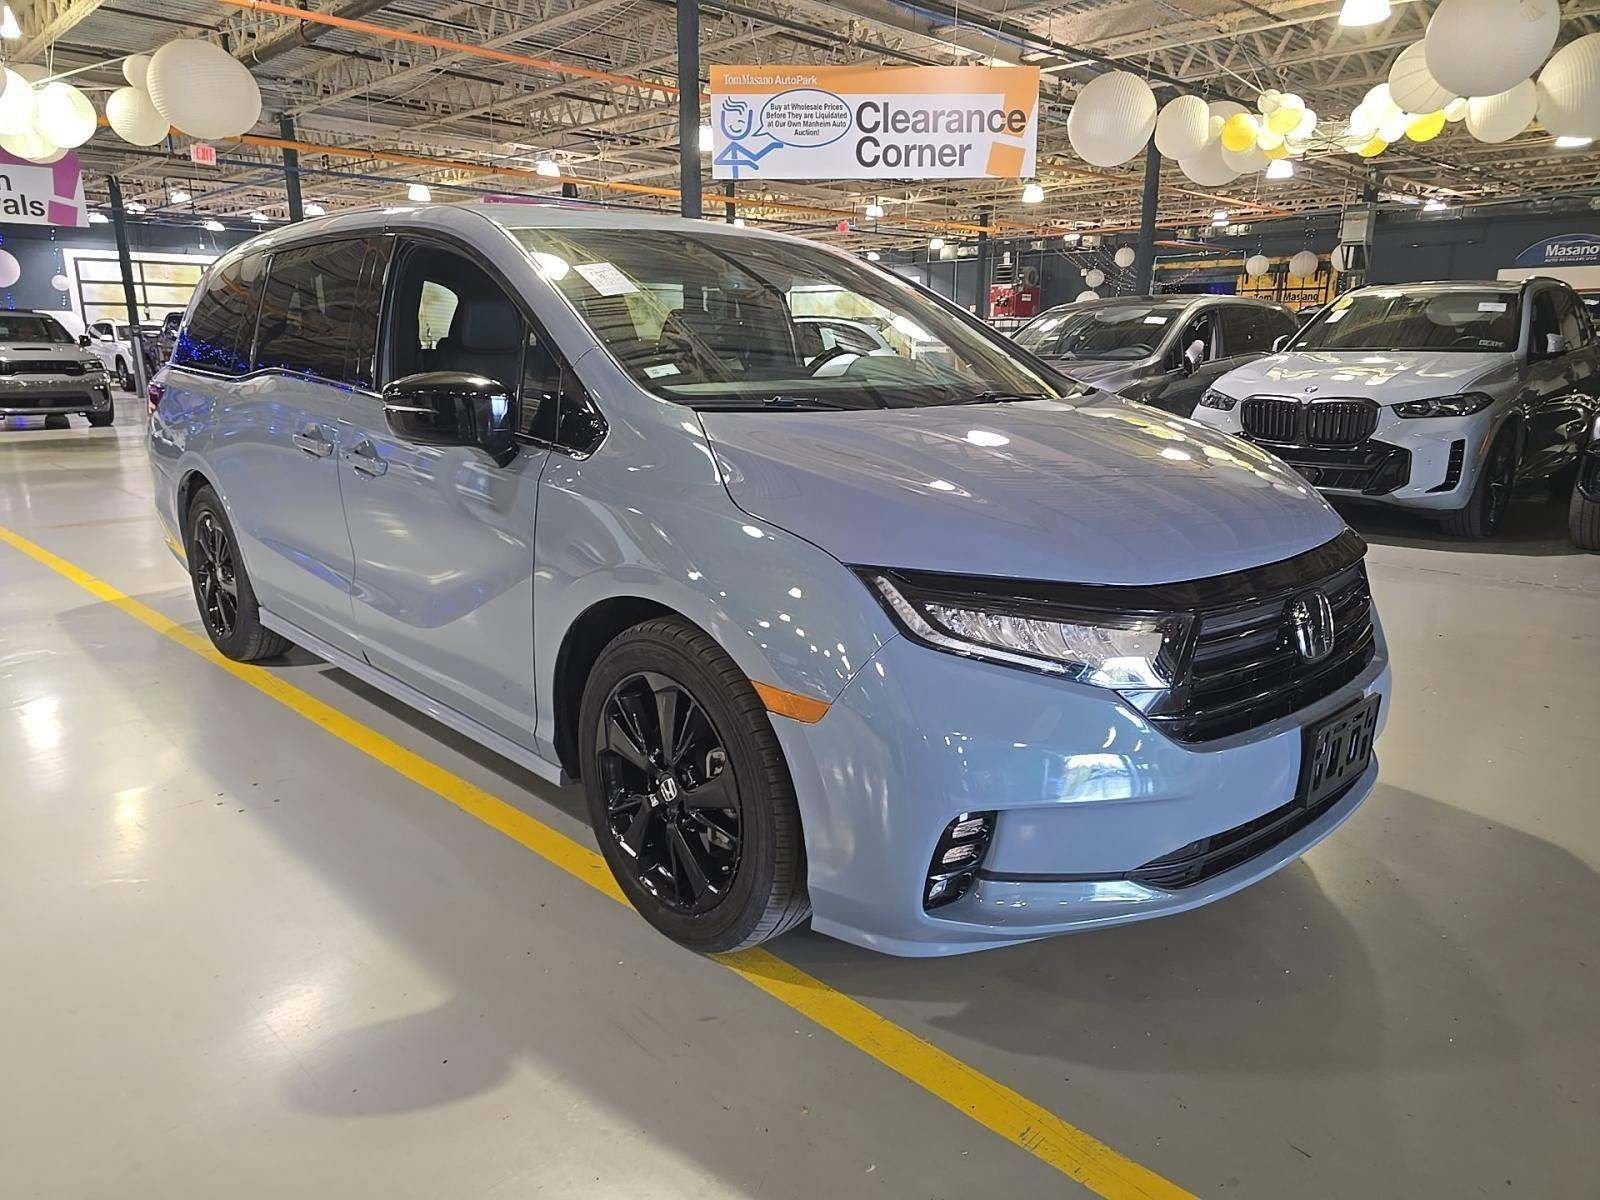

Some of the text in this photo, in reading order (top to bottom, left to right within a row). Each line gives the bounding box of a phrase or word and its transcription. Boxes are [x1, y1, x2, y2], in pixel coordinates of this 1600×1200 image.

[723, 74, 817, 85] Tom Masano AutoPark
[770, 103, 782, 111] Buy
[791, 103, 823, 111] Wholesale
[824, 103, 843, 111] Prices
[788, 112, 802, 120] They
[815, 112, 848, 120] Liquidated
[856, 101, 1027, 134] Clearance
[196, 147, 212, 161] EXIT
[856, 136, 972, 168] Corner
[0, 194, 46, 217] als
[1545, 244, 1600, 257] Masano
[1284, 292, 1319, 301] Masano
